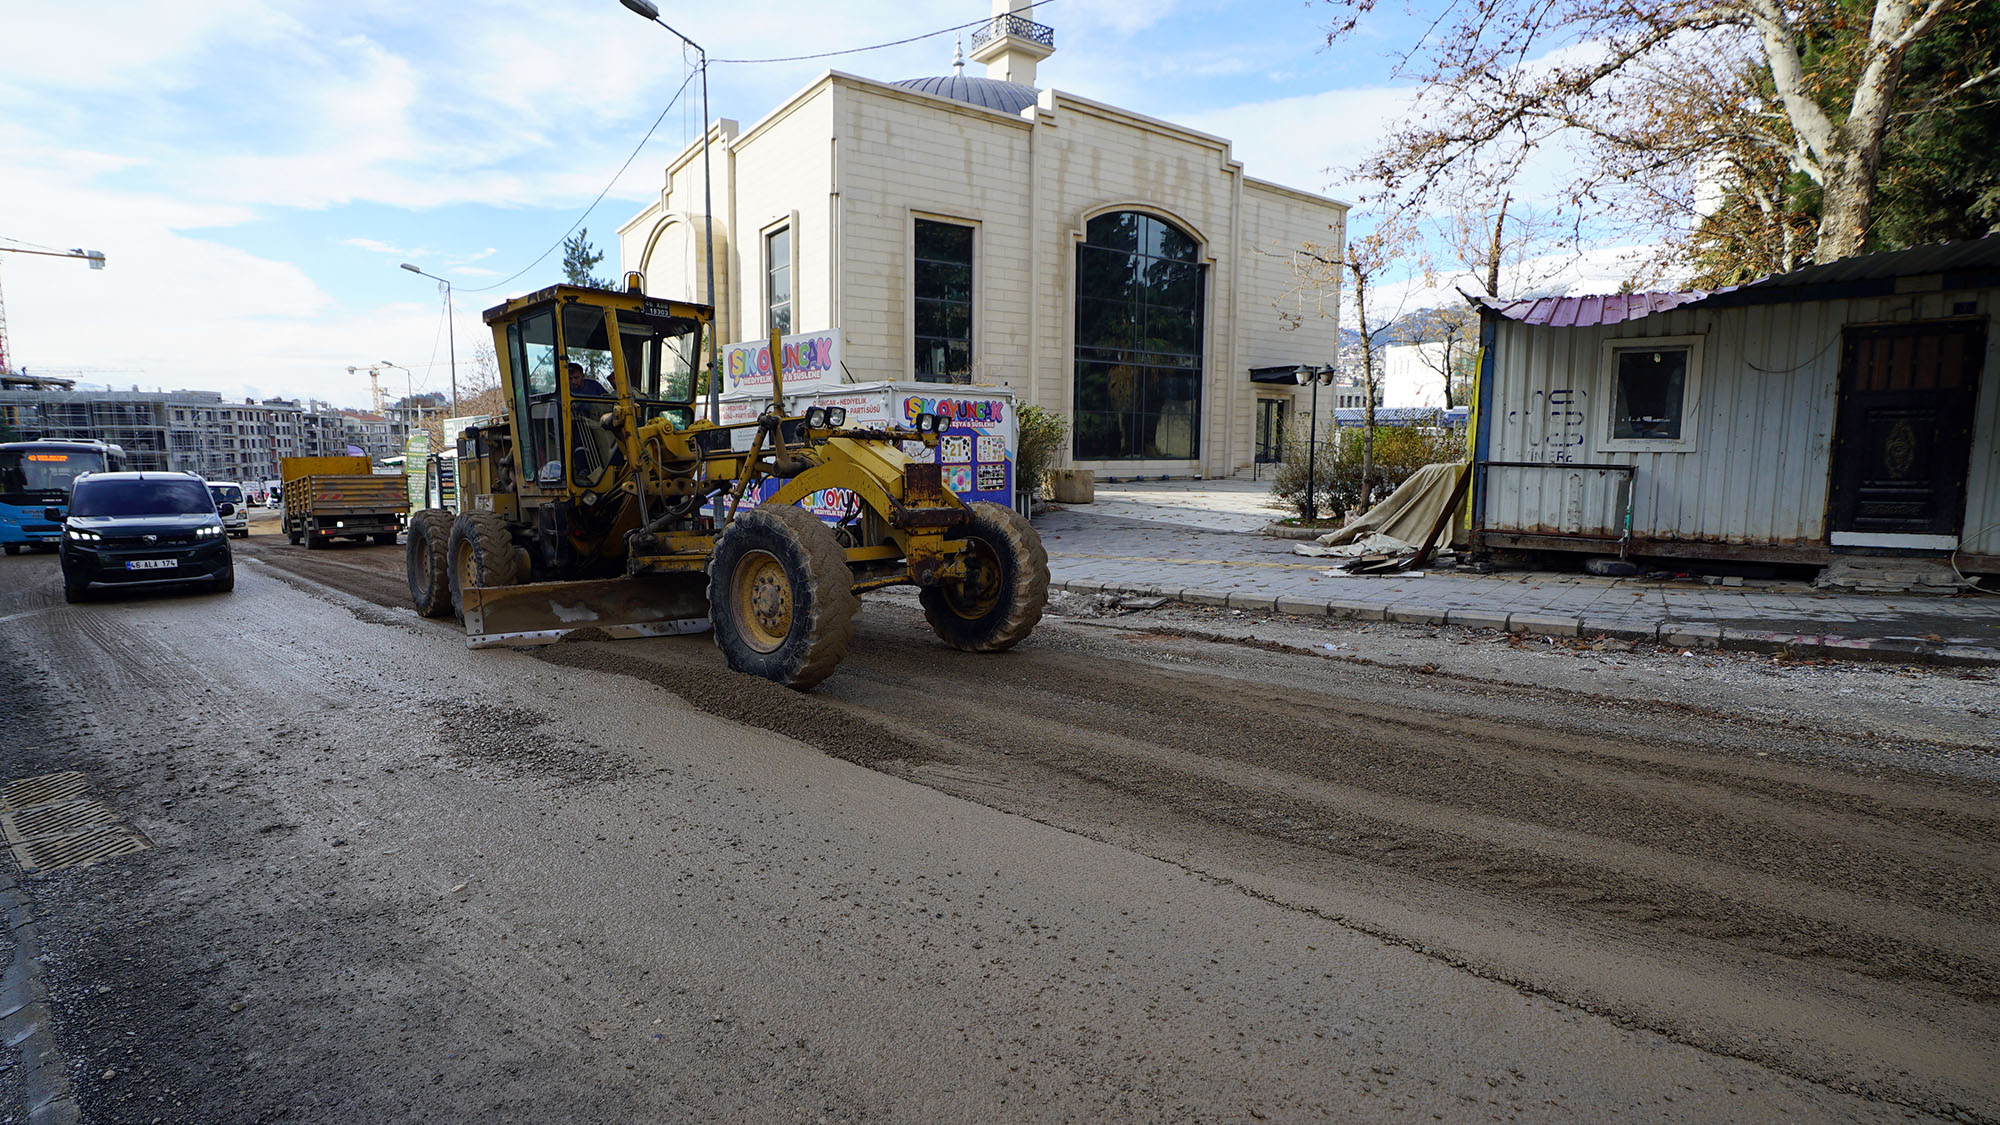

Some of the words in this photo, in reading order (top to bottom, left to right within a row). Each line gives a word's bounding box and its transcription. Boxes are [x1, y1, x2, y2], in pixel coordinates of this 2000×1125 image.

[728, 347, 757, 388] IŞIK
[758, 337, 832, 372] OUNCAK
[904, 396, 936, 428] IŞIK
[937, 398, 1004, 423] OYUNCAK
[950, 443, 962, 456] 21
